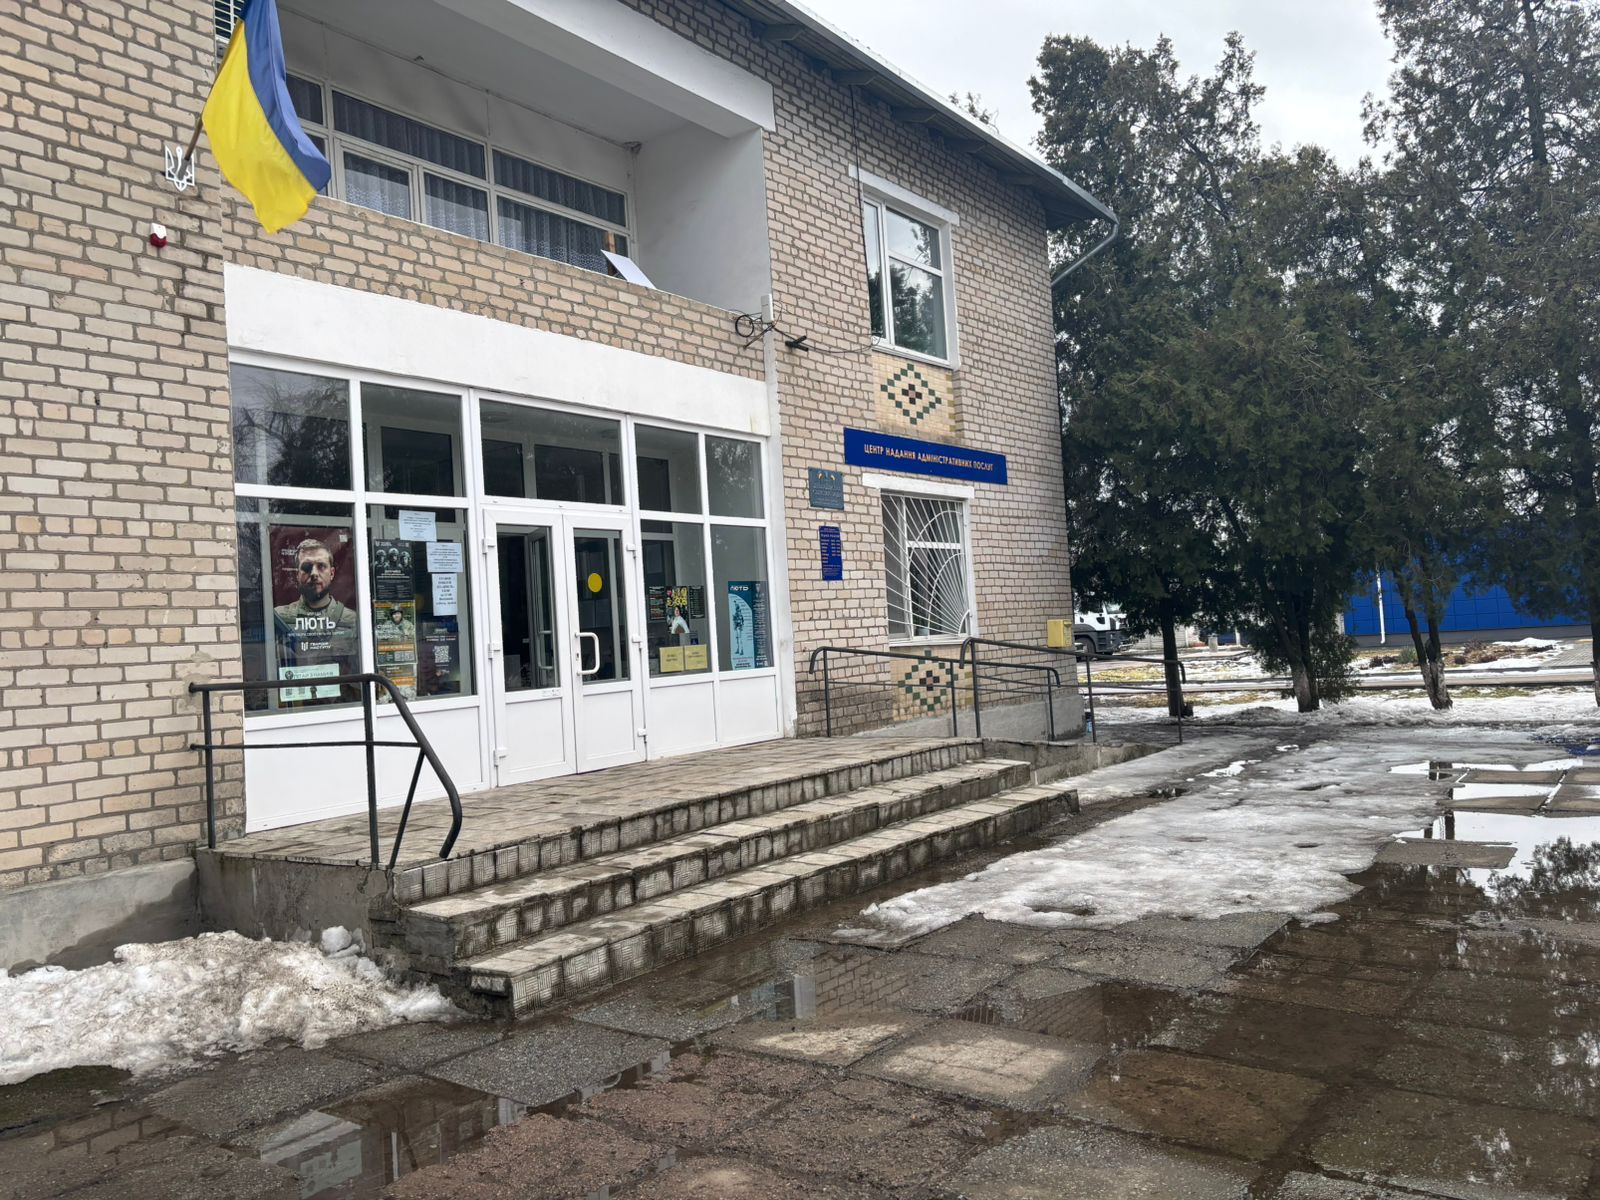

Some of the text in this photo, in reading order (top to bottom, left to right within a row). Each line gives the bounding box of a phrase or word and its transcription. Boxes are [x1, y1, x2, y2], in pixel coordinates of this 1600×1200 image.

[864, 444, 994, 471] ЦЕНТР НАДАННЯ АДМІНІСТРАТИВНИХ ПОСЛУГ
[294, 617, 336, 630] ЛЮТЬ
